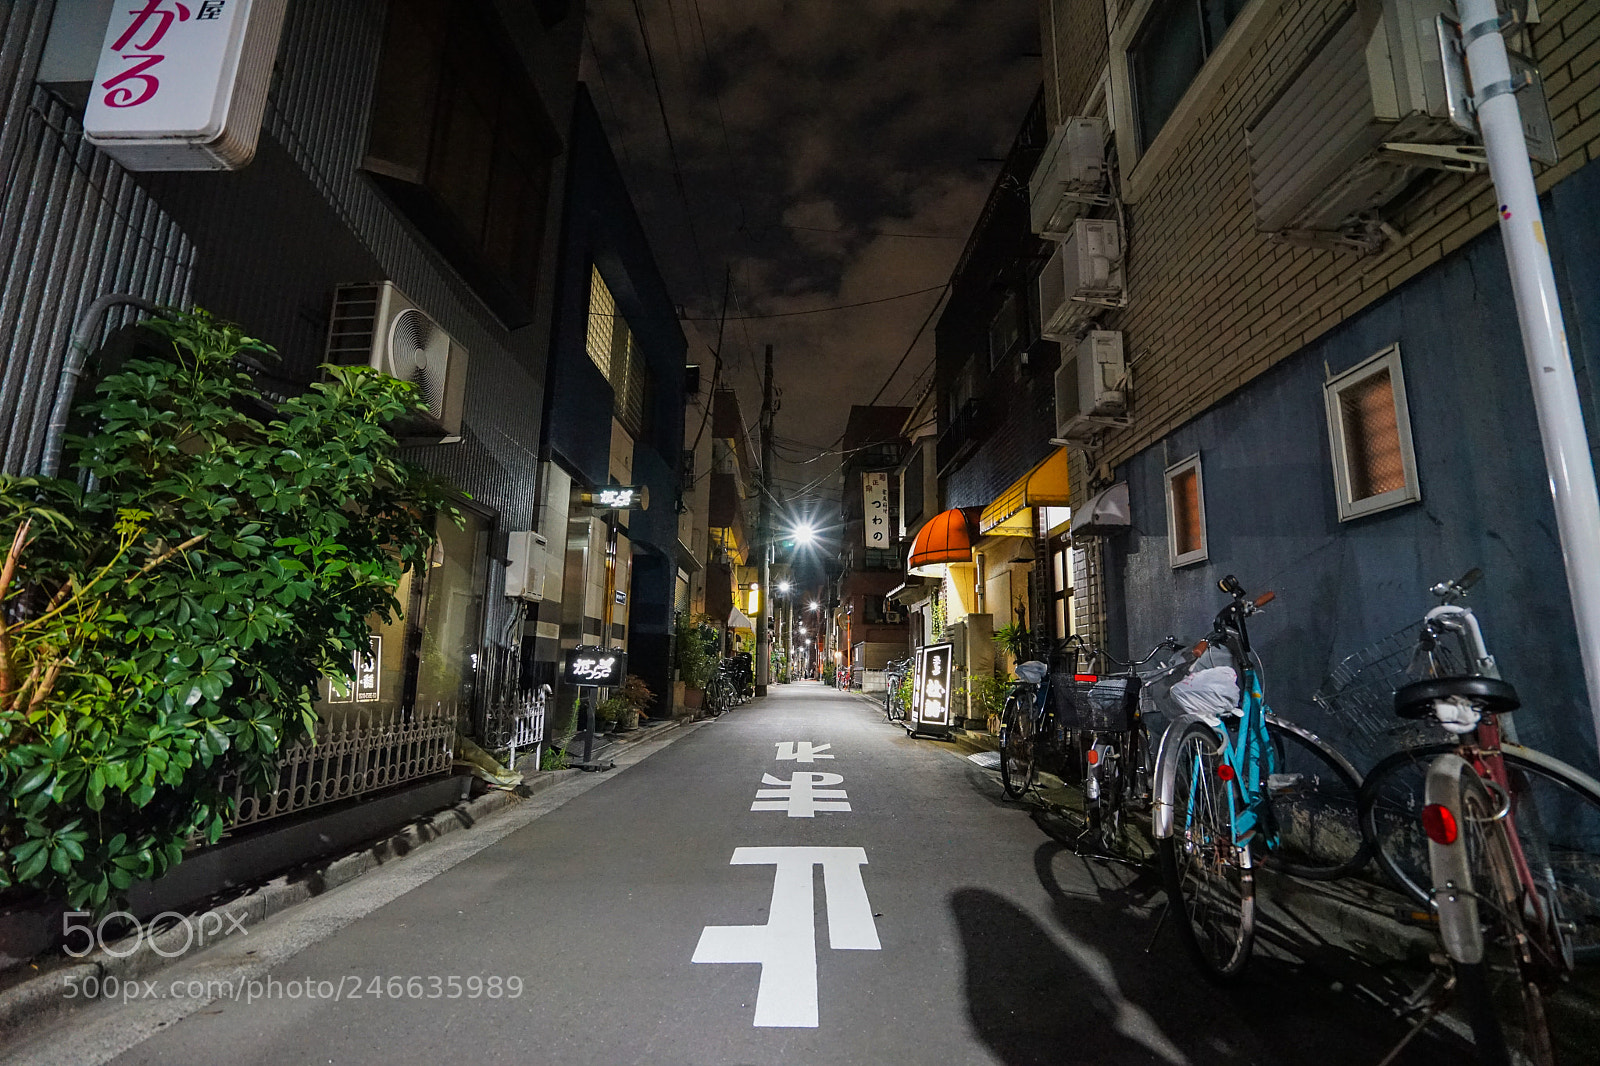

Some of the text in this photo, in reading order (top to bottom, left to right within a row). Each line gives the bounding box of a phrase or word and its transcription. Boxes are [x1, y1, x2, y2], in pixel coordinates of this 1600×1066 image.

[871, 500, 883, 541] つわの
[691, 741, 882, 1027] 止まれ
